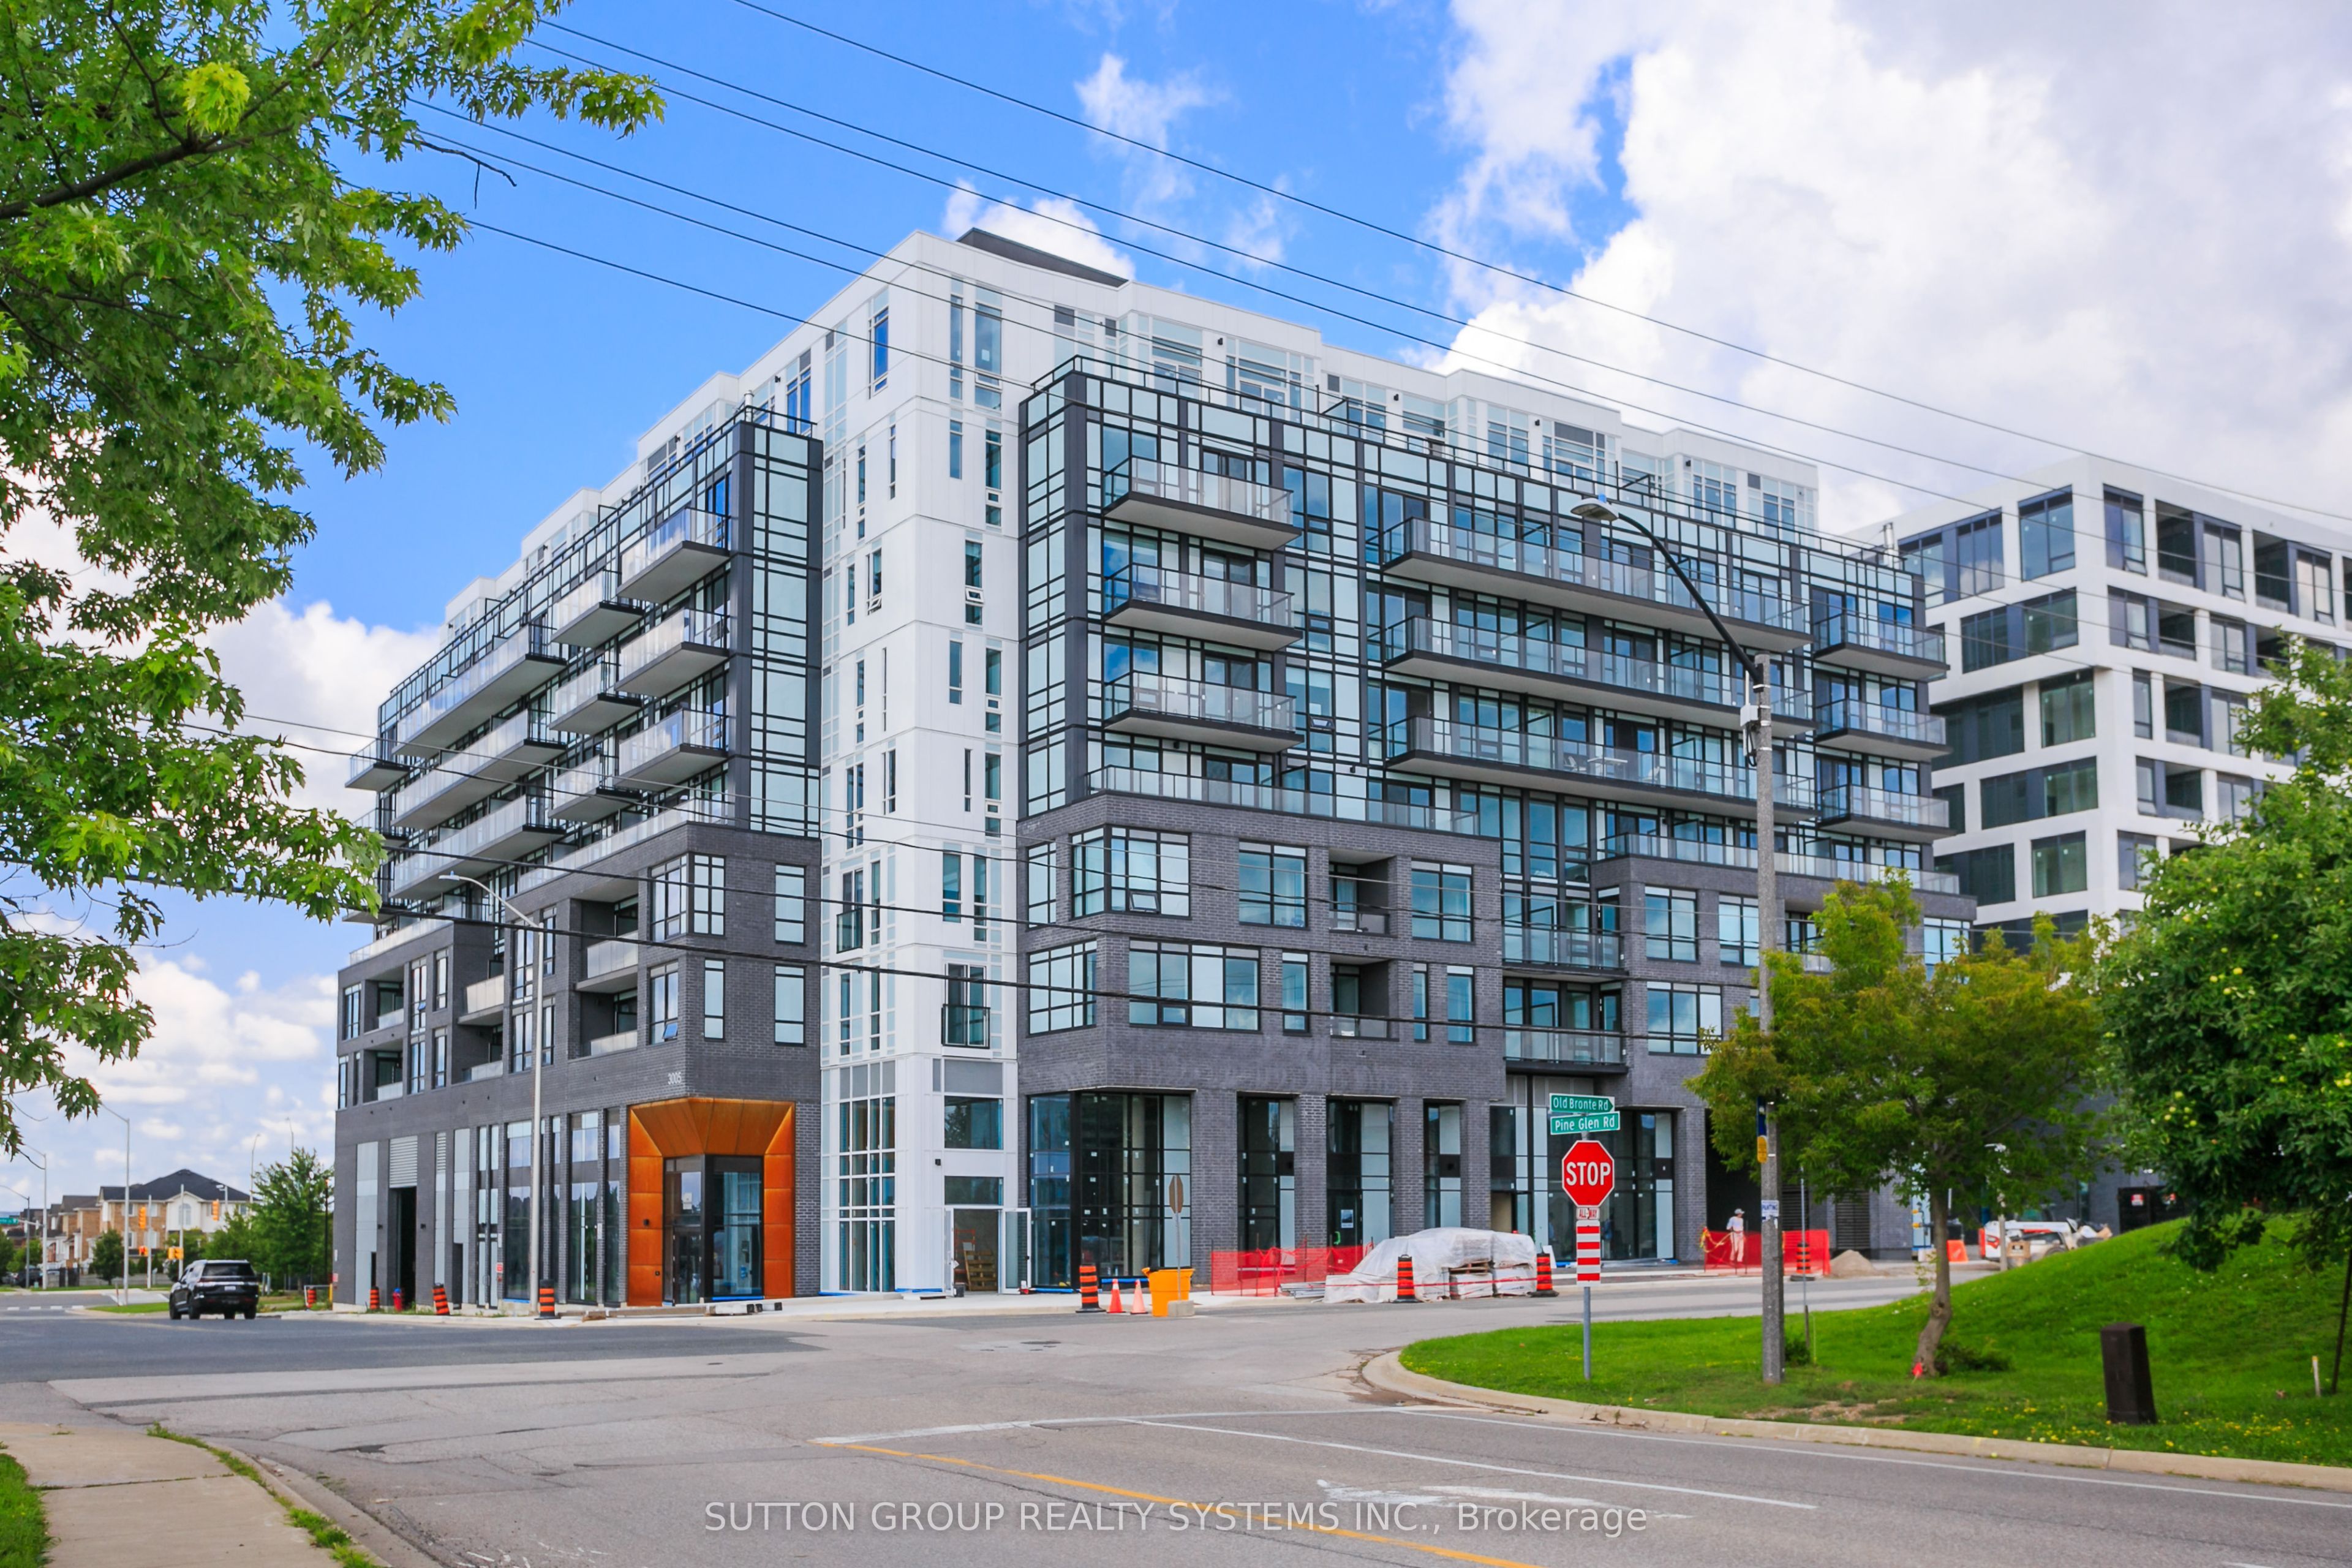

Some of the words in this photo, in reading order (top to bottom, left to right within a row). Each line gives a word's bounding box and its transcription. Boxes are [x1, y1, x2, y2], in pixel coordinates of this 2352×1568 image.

[1553, 1097, 1567, 1109] Old
[1569, 1098, 1597, 1110] Bronte
[1598, 1099, 1608, 1110] Rd
[1555, 1118, 1575, 1131] Pine
[1578, 1117, 1599, 1130] Glen
[1603, 1115, 1615, 1128] Rd
[1566, 1161, 1611, 1186] STOP
